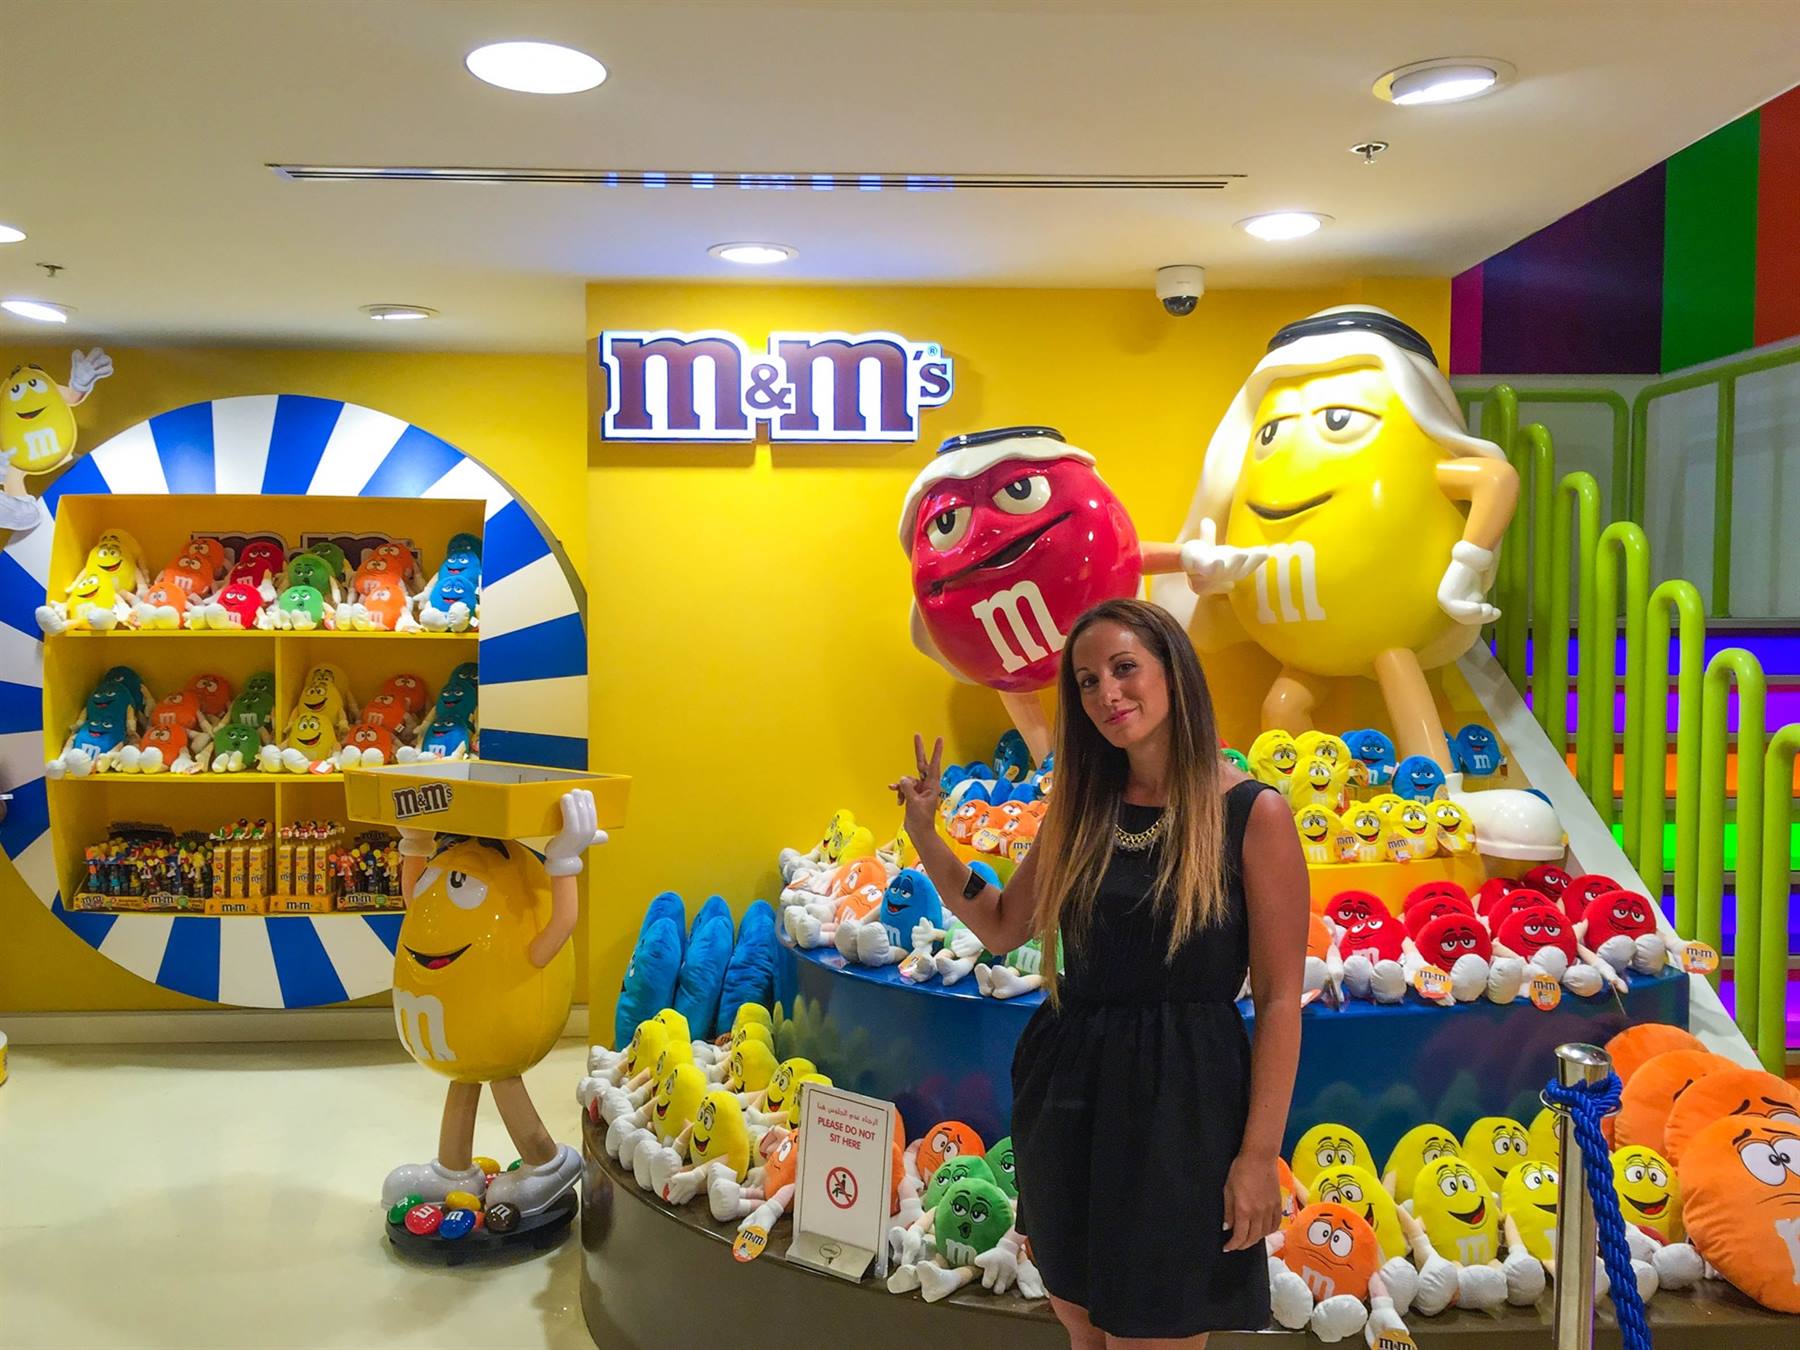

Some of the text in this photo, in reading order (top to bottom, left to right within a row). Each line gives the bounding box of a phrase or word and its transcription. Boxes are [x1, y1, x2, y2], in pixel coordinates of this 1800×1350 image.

[24, 428, 61, 460] m
[1256, 540, 1327, 624] m
[971, 580, 1067, 673] m
[240, 713, 258, 727] m
[1473, 754, 1491, 769] m
[392, 986, 458, 1062] m
[817, 1116, 876, 1141] PLEASE DO NOT
[830, 1133, 861, 1150] SIT HERE
[946, 1238, 977, 1266] m
[1456, 1233, 1489, 1265] m
[1302, 1265, 1335, 1300] m
